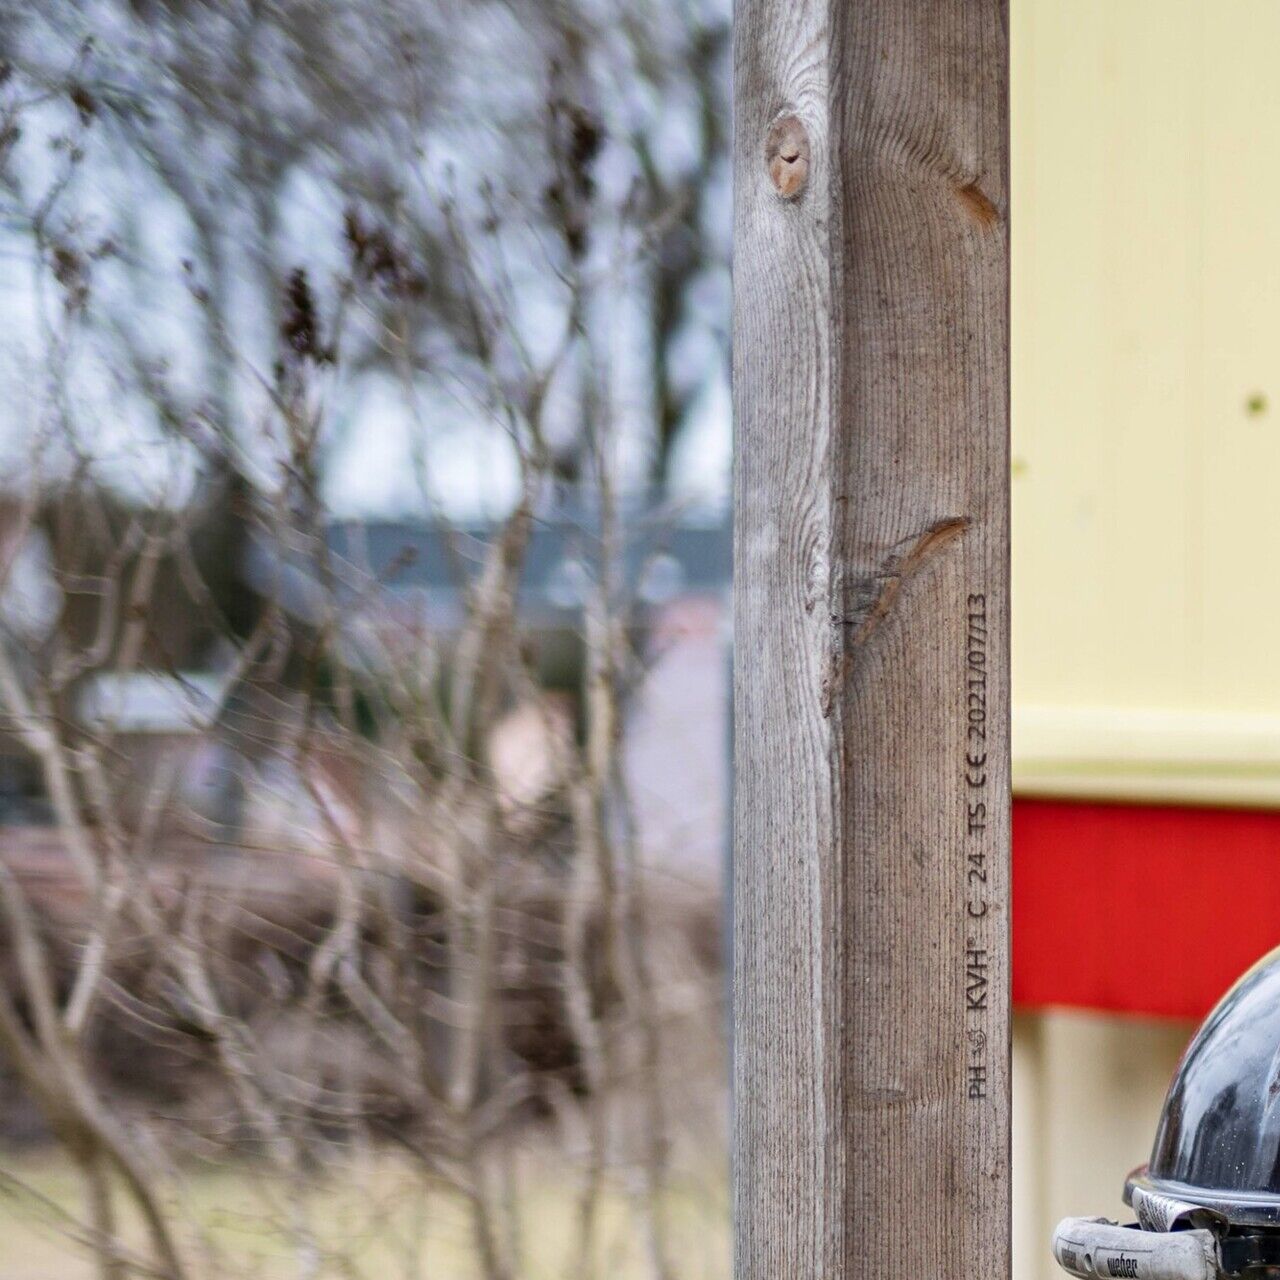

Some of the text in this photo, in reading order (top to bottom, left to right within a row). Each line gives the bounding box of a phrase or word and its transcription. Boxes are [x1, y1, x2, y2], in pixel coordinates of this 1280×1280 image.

[967, 593, 988, 740] 2021/07/13
[967, 804, 987, 837] TS
[967, 852, 987, 885] 24
[967, 900, 987, 919] C
[968, 1066, 987, 1099] PH
